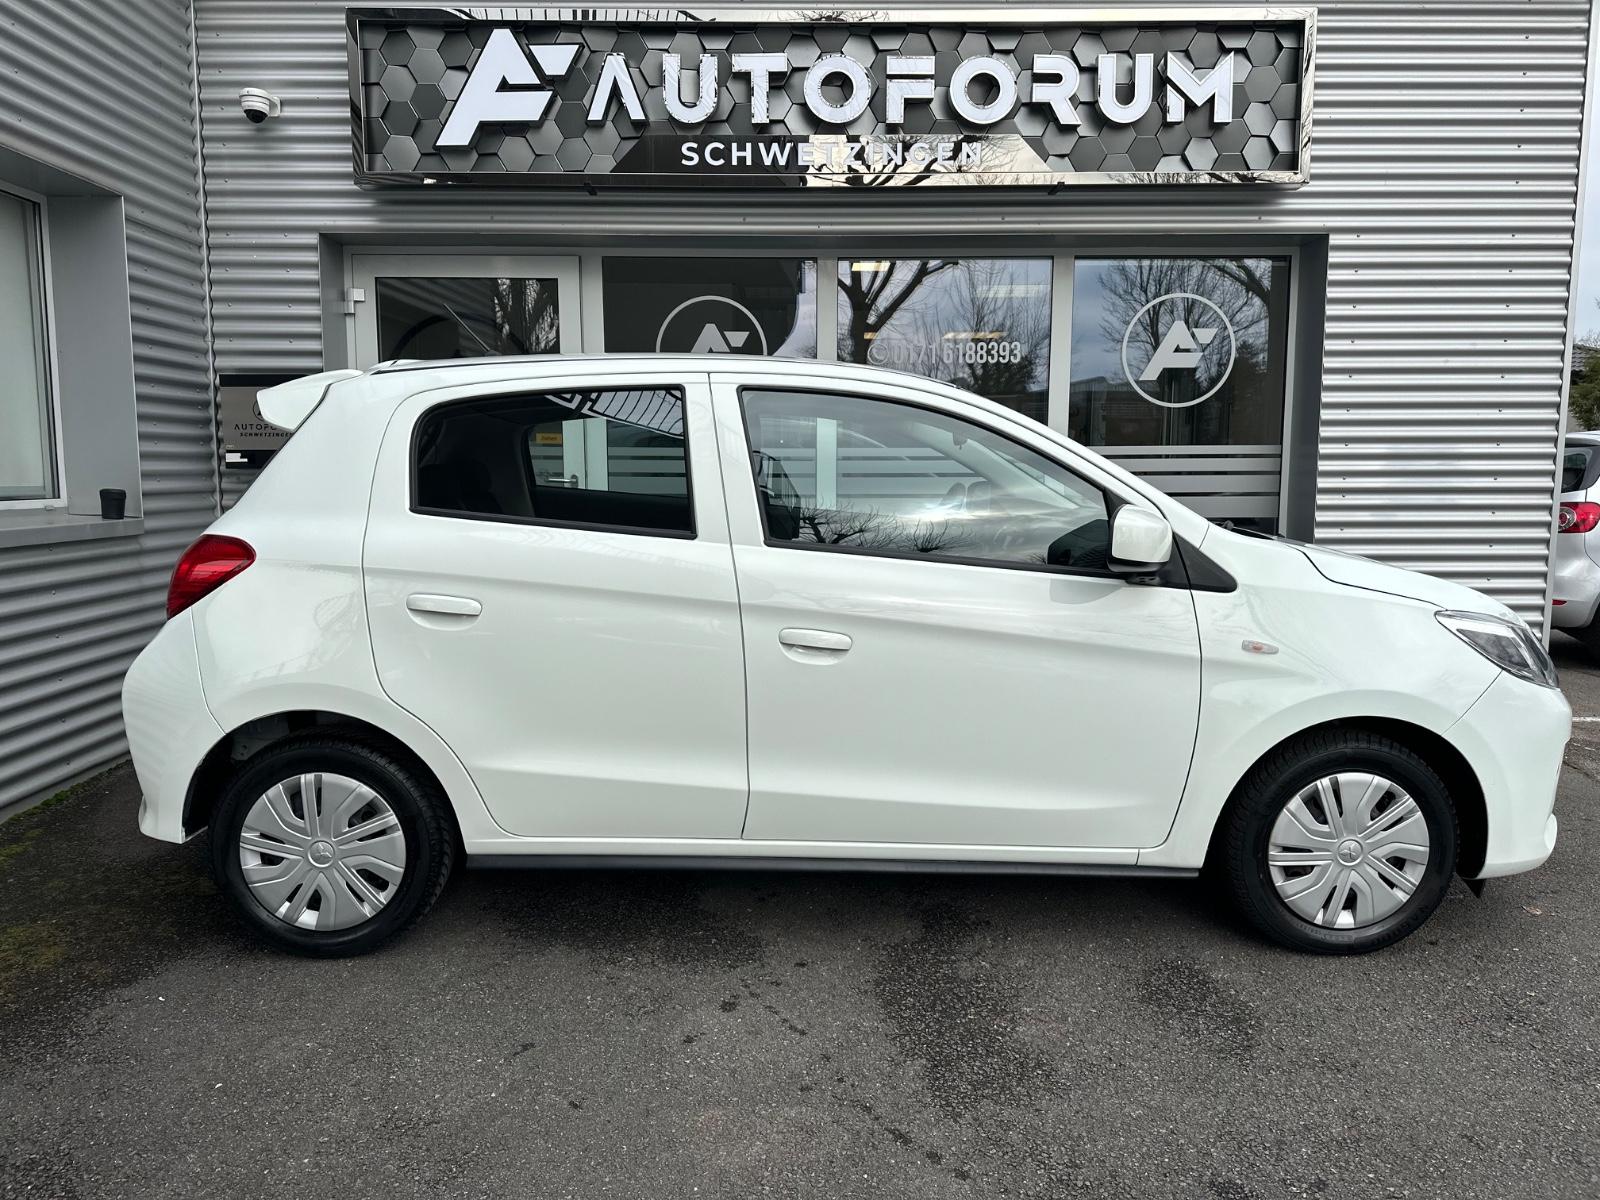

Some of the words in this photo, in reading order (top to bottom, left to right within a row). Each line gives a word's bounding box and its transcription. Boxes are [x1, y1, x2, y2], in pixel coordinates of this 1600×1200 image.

[587, 51, 1236, 126] AUTOFORUM
[680, 141, 983, 167] SCHWETZINGEN
[942, 341, 1022, 364] 6188393
[234, 423, 277, 431] AUTOF
